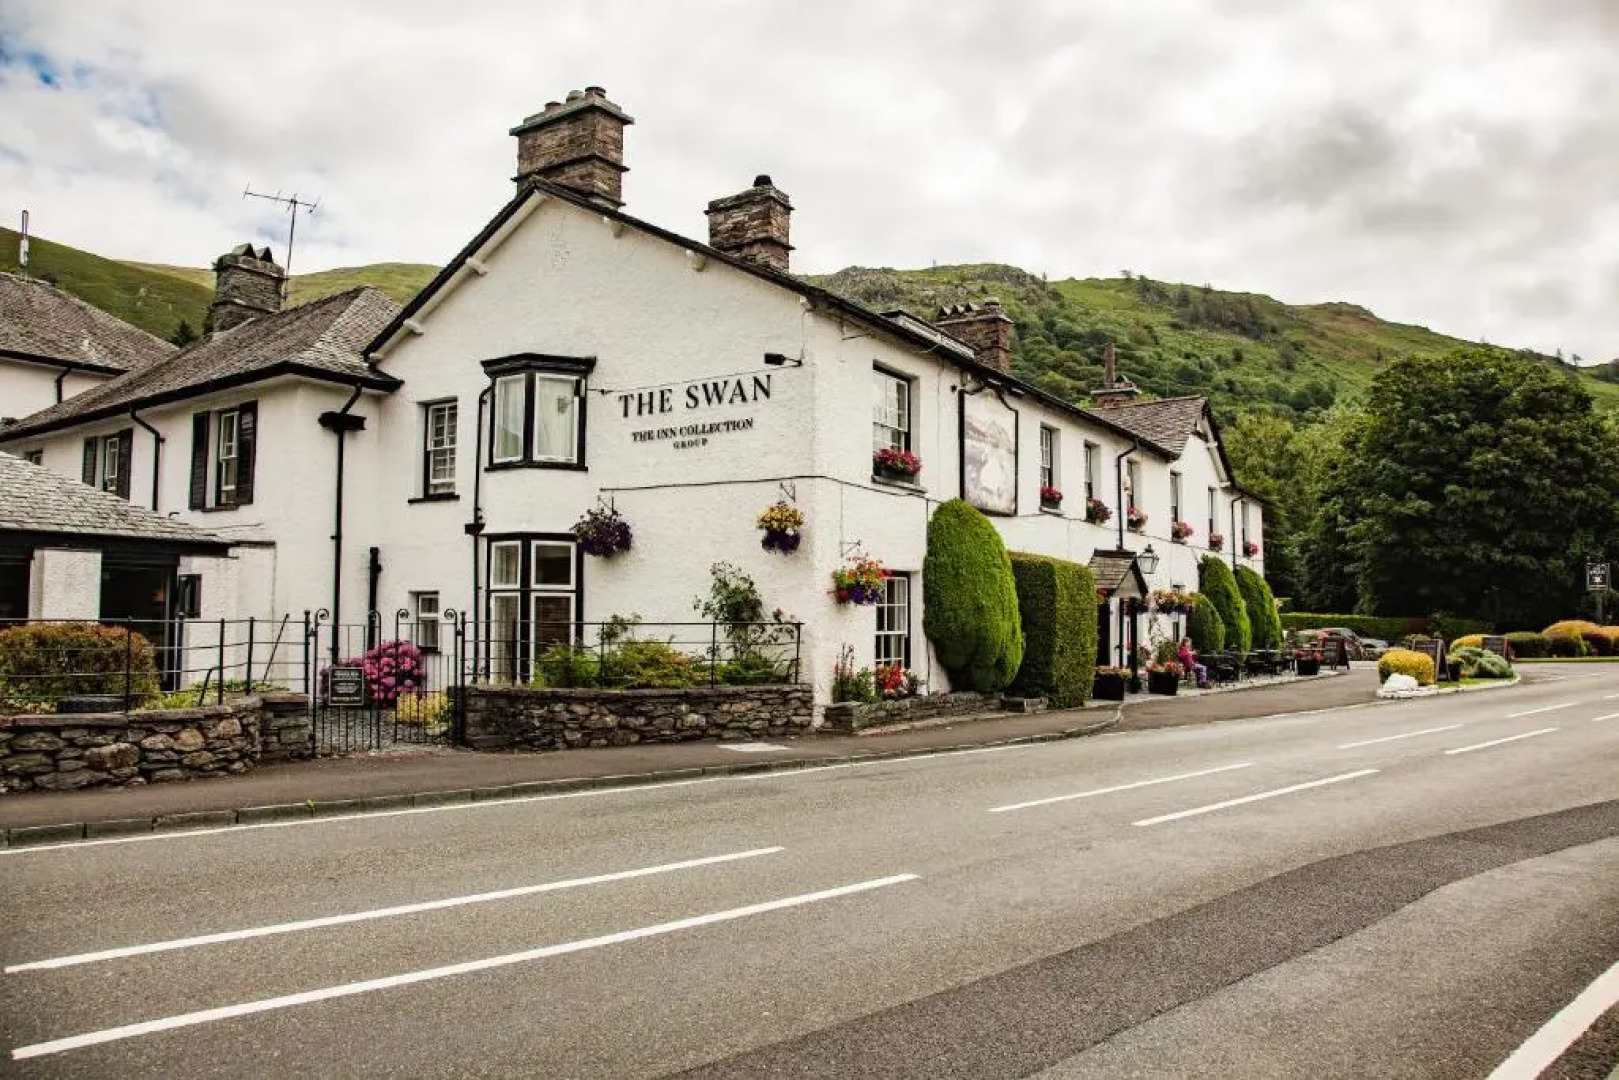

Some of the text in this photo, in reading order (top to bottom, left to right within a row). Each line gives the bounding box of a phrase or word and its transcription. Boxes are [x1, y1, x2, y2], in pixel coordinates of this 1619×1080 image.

[618, 374, 772, 418] THE SWAN
[631, 418, 754, 442] THE INN COLLECTION
[673, 437, 708, 449] GROUP
